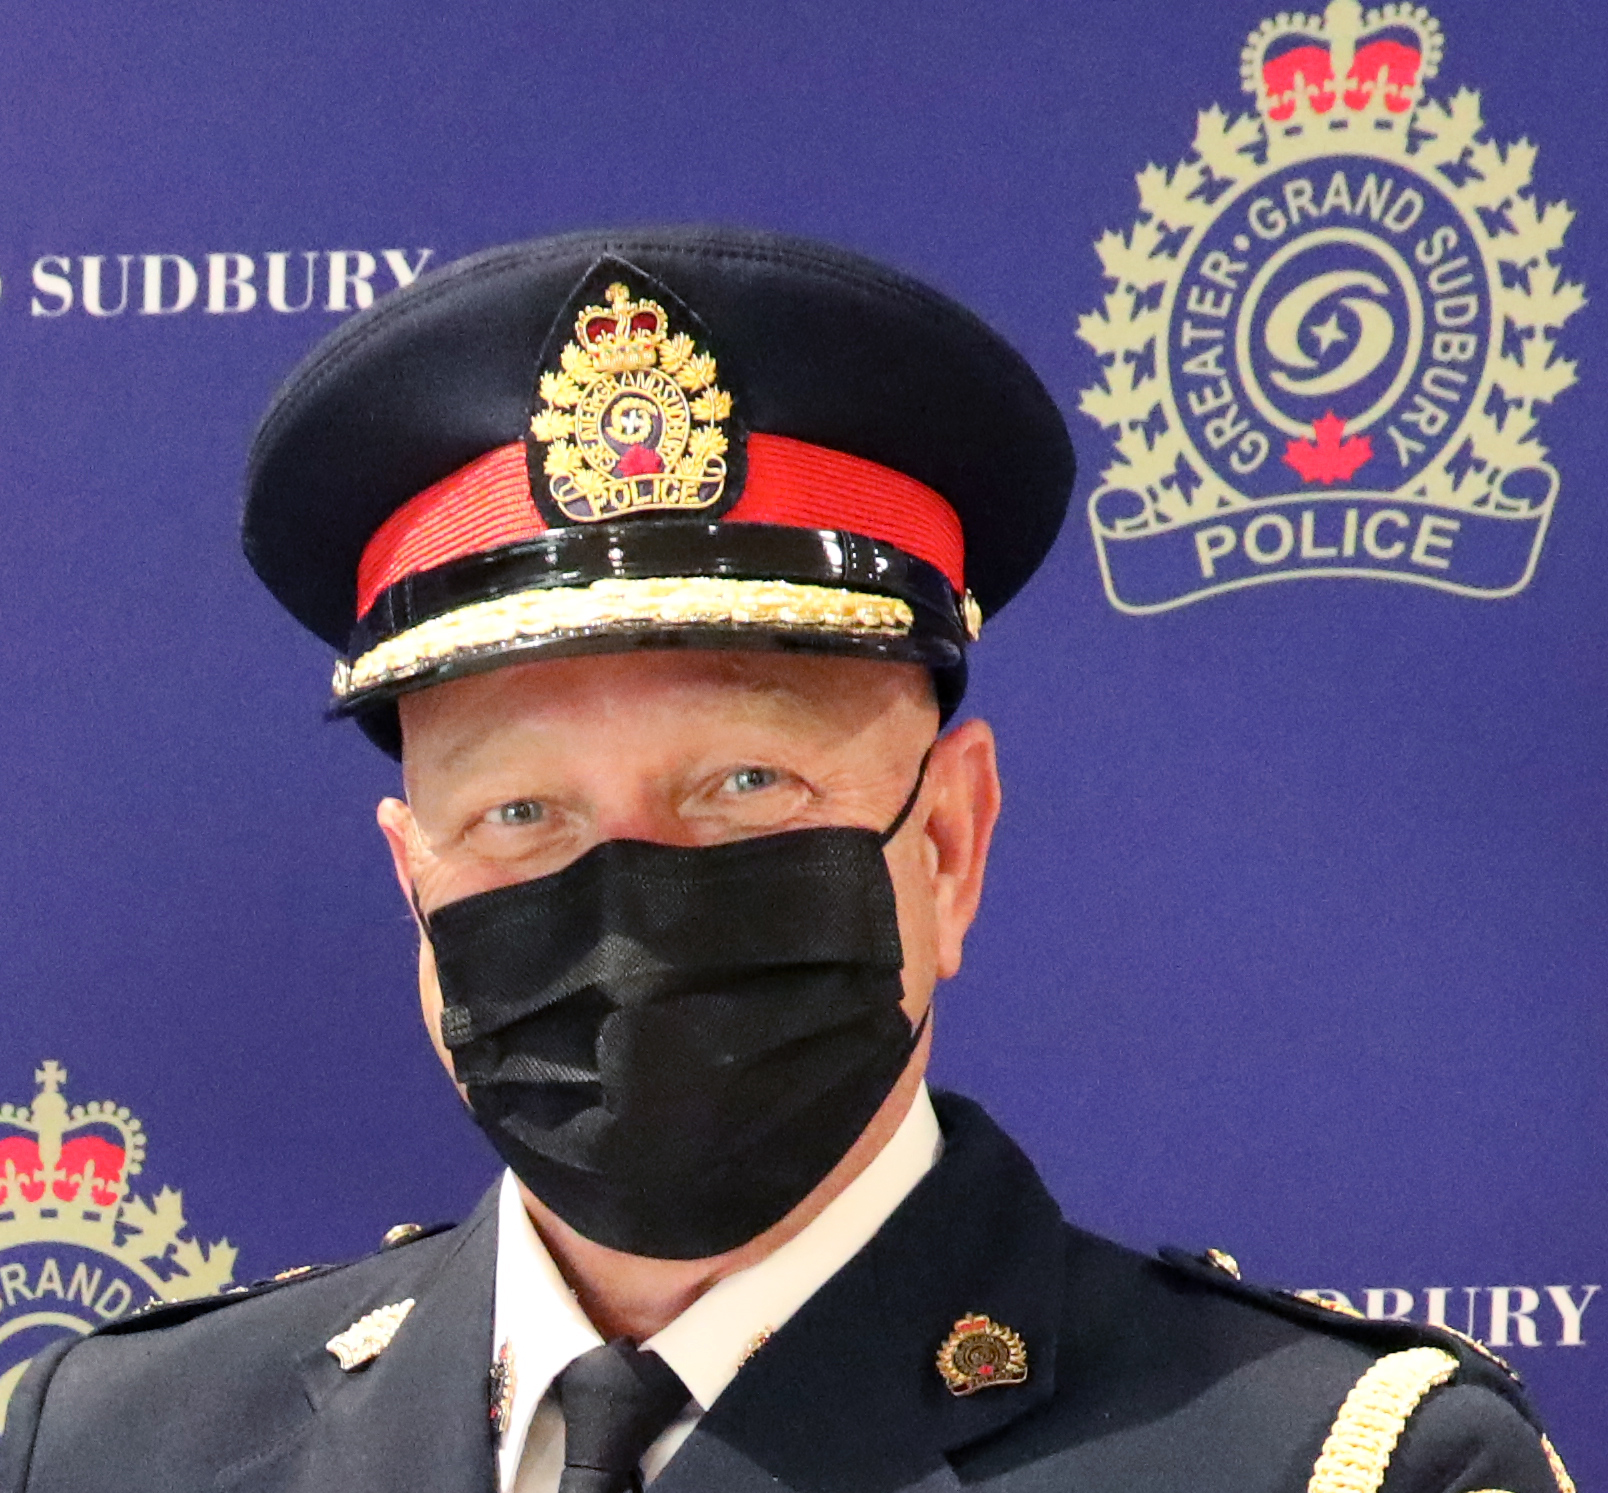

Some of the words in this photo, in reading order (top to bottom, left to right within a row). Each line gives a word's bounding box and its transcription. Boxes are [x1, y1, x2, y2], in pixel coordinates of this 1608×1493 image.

[32, 249, 432, 316] SUDBURY
[1181, 251, 1269, 474] GREATER
[1248, 171, 1423, 240] GRAND
[1387, 226, 1478, 467] SUDBURY
[587, 478, 701, 518] POLICE
[1195, 508, 1460, 578] POLICE
